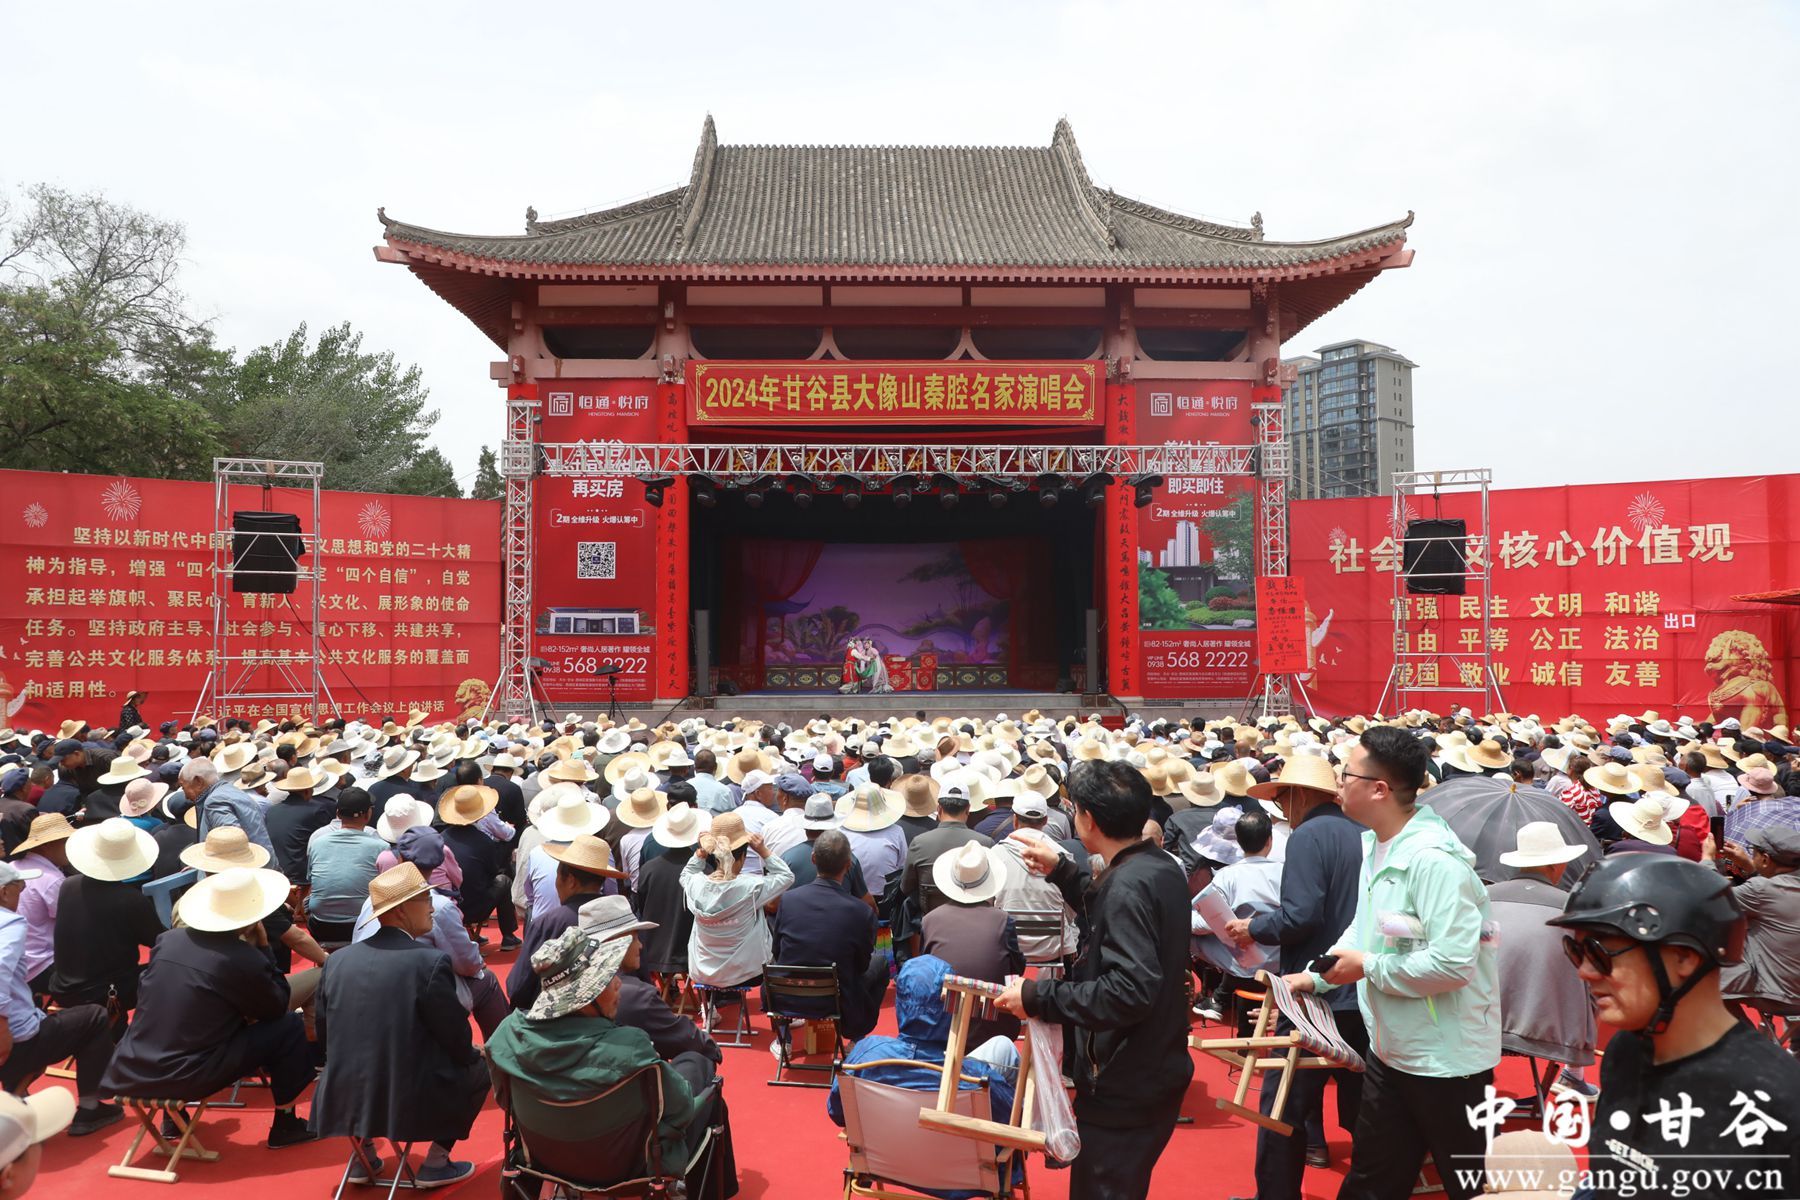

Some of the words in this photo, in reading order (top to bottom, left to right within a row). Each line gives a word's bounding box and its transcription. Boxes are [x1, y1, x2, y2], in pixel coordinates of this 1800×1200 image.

[705, 373, 1086, 411] 2024年甘谷县大像山秦腔名家演唱会
[572, 479, 624, 498] 再买房
[1168, 478, 1224, 494] 即买即住
[73, 527, 471, 560] 坚持以新时代中国主义思想和党的二十大精
[1329, 523, 1734, 574] 社会义核心价值观
[1390, 596, 1439, 620] 富强
[1459, 595, 1509, 619] 民主
[1530, 593, 1582, 618] 文明
[1604, 591, 1660, 617] 和谐
[1664, 613, 1696, 629] 出口
[1392, 629, 1437, 652] 自由
[1458, 628, 1509, 652] 平等
[1529, 627, 1583, 651] 公正
[1604, 625, 1660, 651] 法治
[563, 657, 597, 673] 568
[1167, 651, 1200, 668] 568
[1205, 651, 1248, 668] 2222
[1459, 662, 1510, 686] 敬业
[1530, 661, 1583, 687] 诚信
[1605, 661, 1661, 688] 友善
